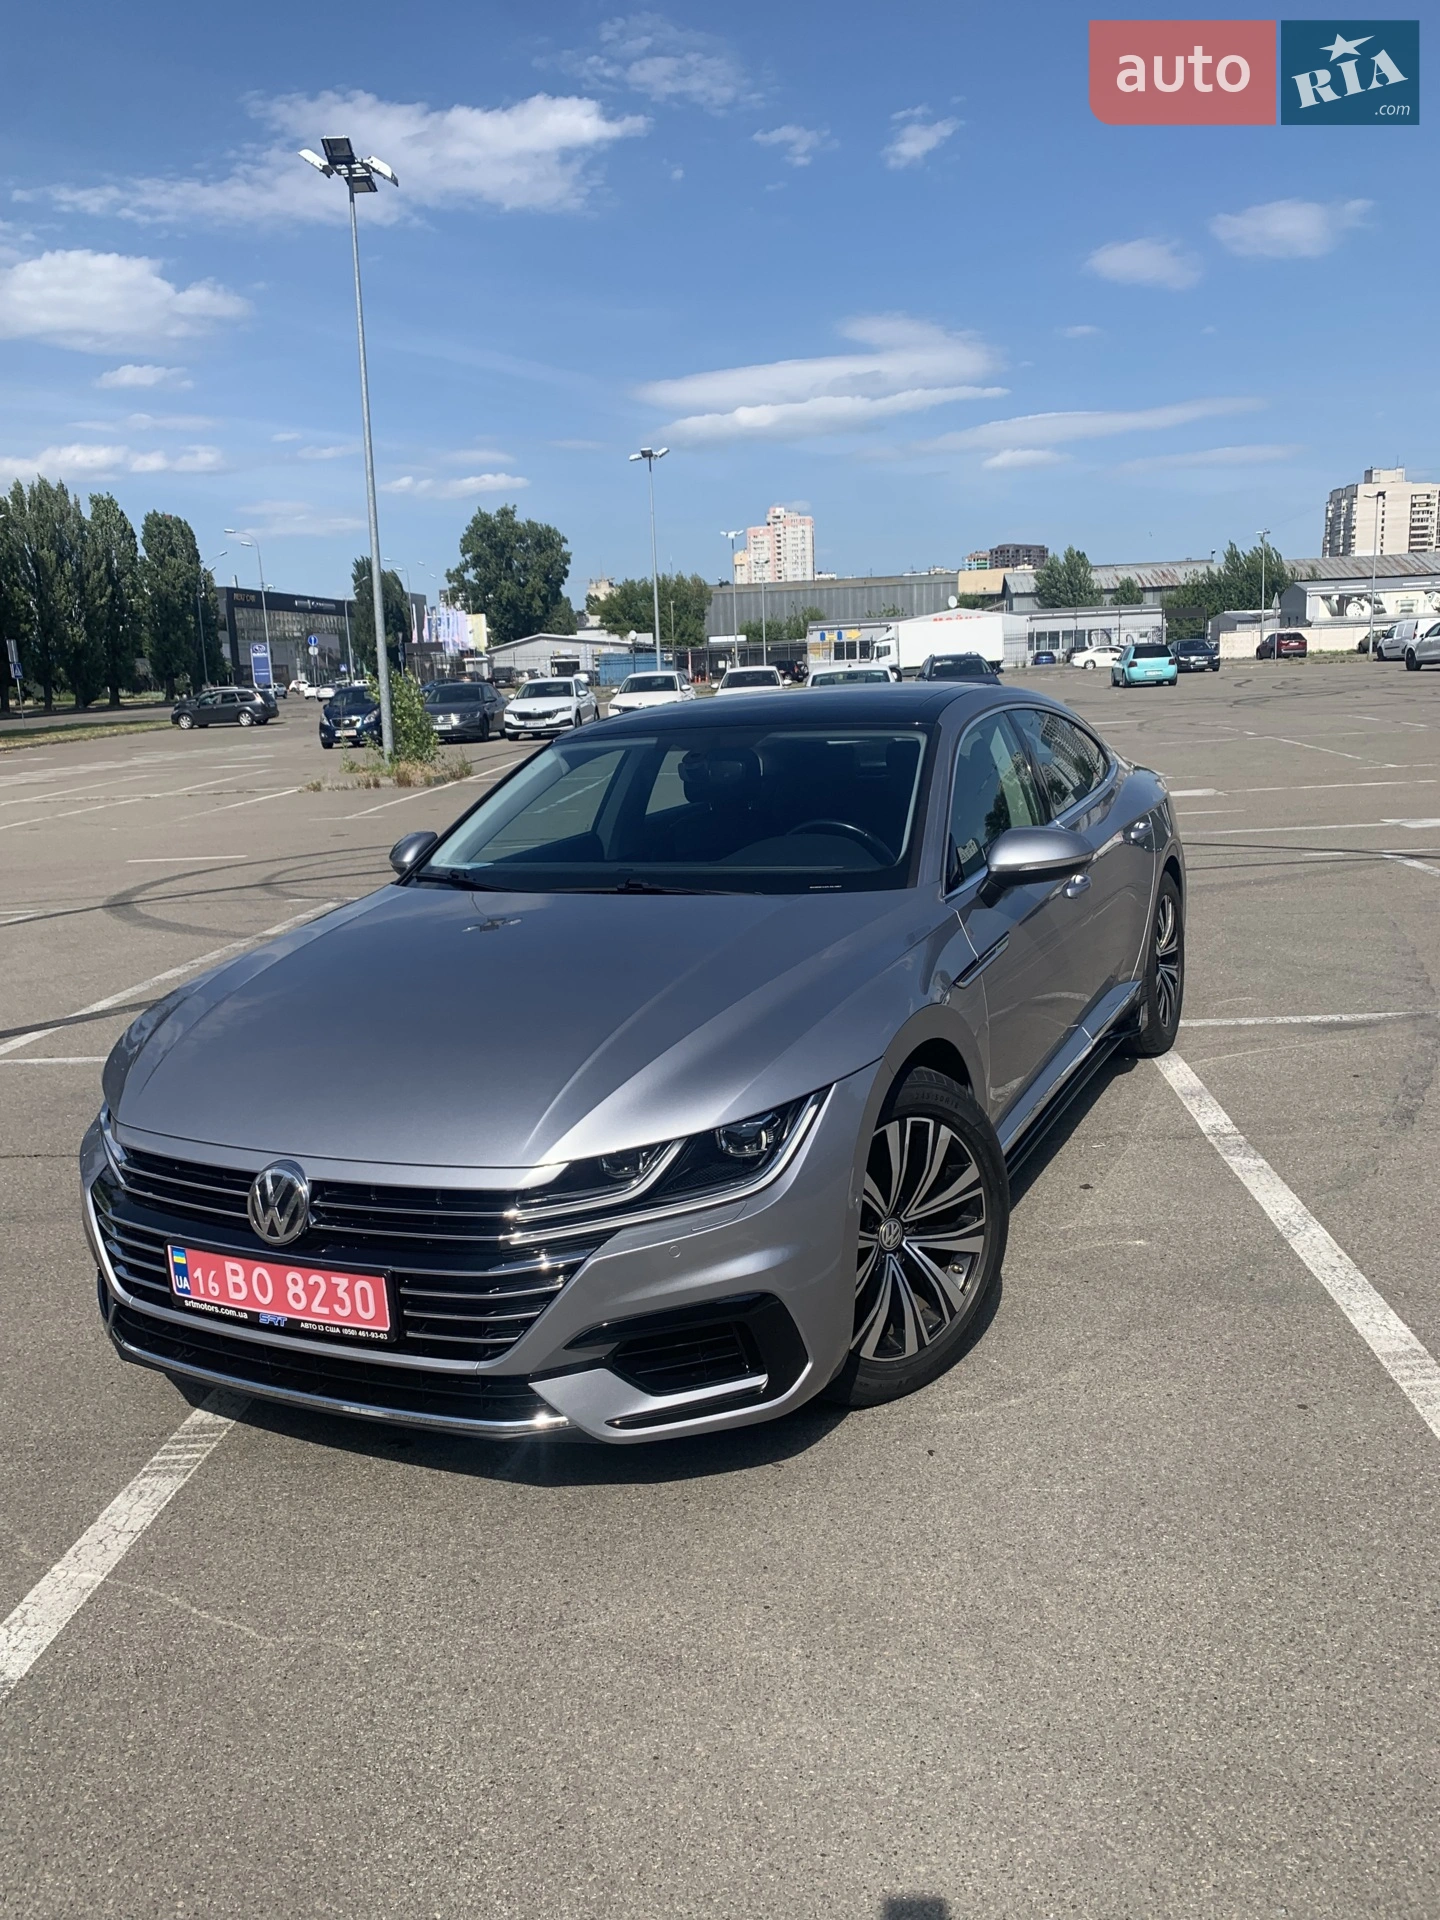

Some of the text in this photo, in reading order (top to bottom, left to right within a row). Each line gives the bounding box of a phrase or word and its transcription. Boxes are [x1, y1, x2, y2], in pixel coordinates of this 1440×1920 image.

[175, 1275, 191, 1290] UA
[192, 1260, 376, 1321] 16 BO 8230
[184, 1299, 248, 1319] srtmotors.com.ua
[259, 1312, 288, 1327] SRT
[300, 1321, 318, 1331] АВТО
[325, 1325, 341, 1334] США
